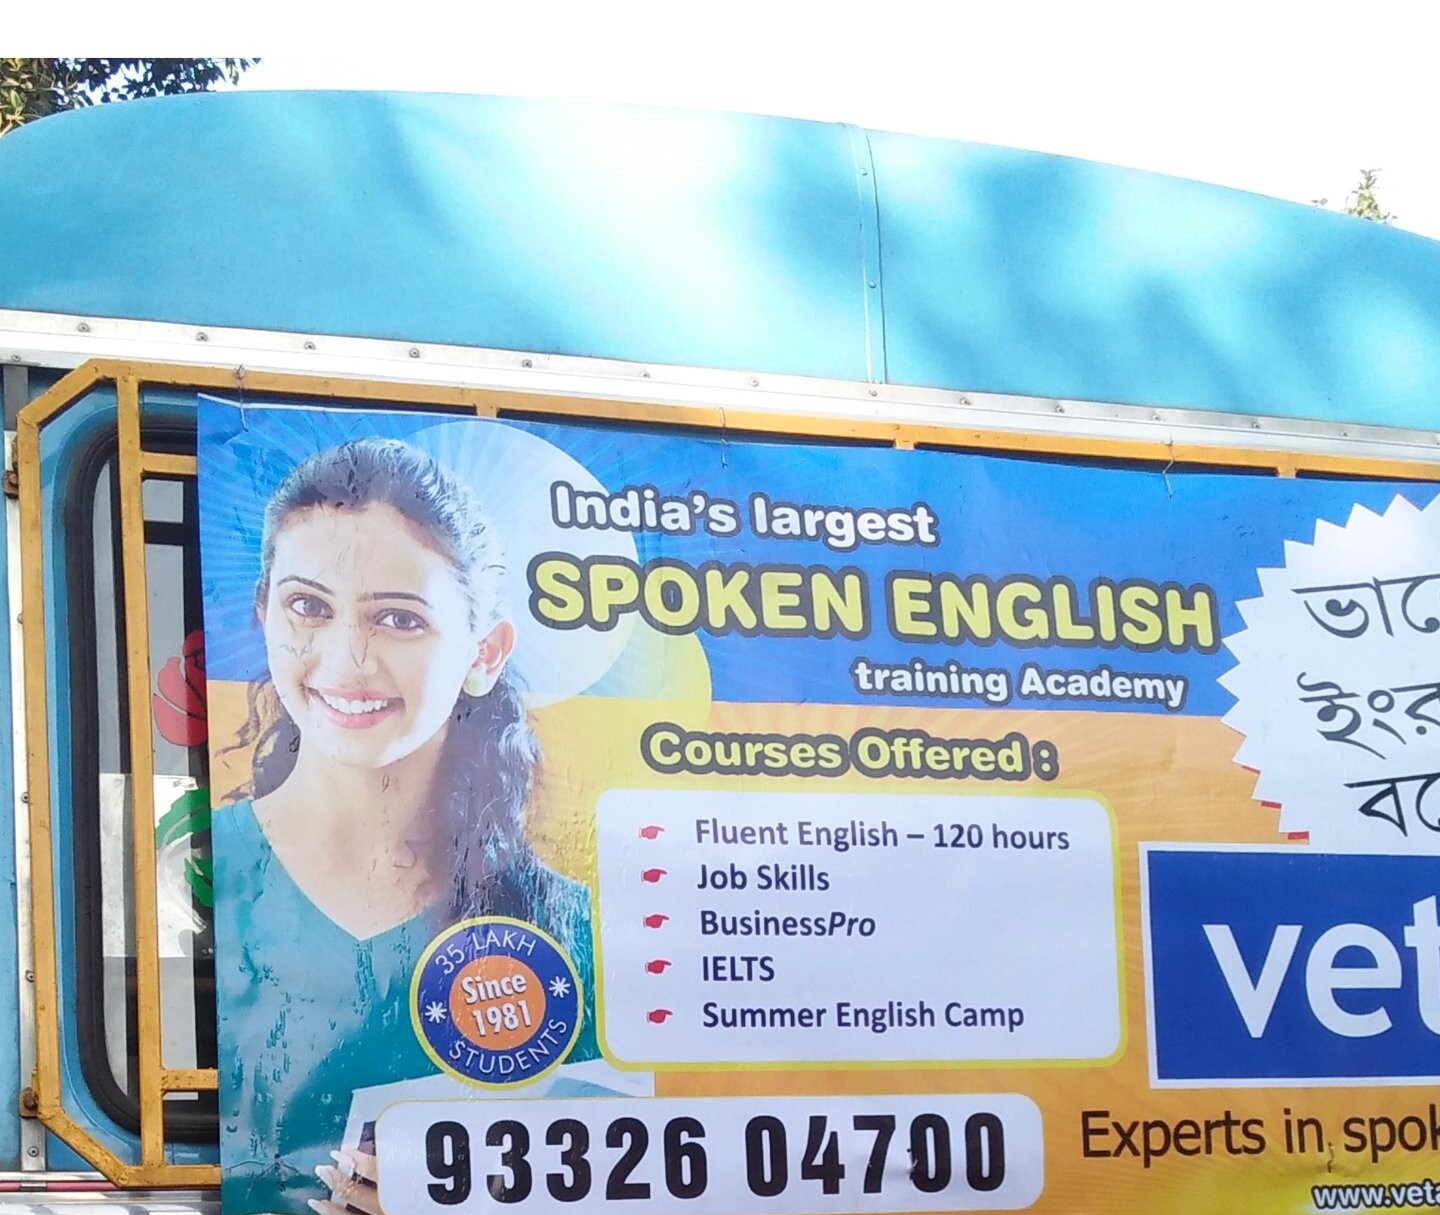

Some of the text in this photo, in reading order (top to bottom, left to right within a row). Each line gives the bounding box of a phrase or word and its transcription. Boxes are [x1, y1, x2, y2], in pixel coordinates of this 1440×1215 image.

[552, 484, 937, 547] India's largest
[536, 560, 1216, 649] SPOKEN ENGLISH
[855, 661, 1187, 708] training Academy
[649, 729, 842, 773] Courses
[858, 735, 1024, 776] Offered
[695, 819, 789, 846] Fluent
[797, 820, 899, 853] English
[933, 823, 984, 849] 120
[992, 823, 1070, 851] hours
[697, 863, 830, 892] Job Skills
[700, 909, 877, 937] BusinessPro
[435, 930, 537, 975] 35 LAKH
[701, 955, 776, 983] IELTS
[461, 973, 528, 1005] Since
[472, 1000, 533, 1037] 1981
[702, 1001, 1025, 1034] Summer English Camp
[449, 1018, 568, 1075] STUDENTS
[424, 1111, 1006, 1206] 93326 04700
[1081, 1108, 1266, 1168] Experts
[1284, 1107, 1325, 1154] in
